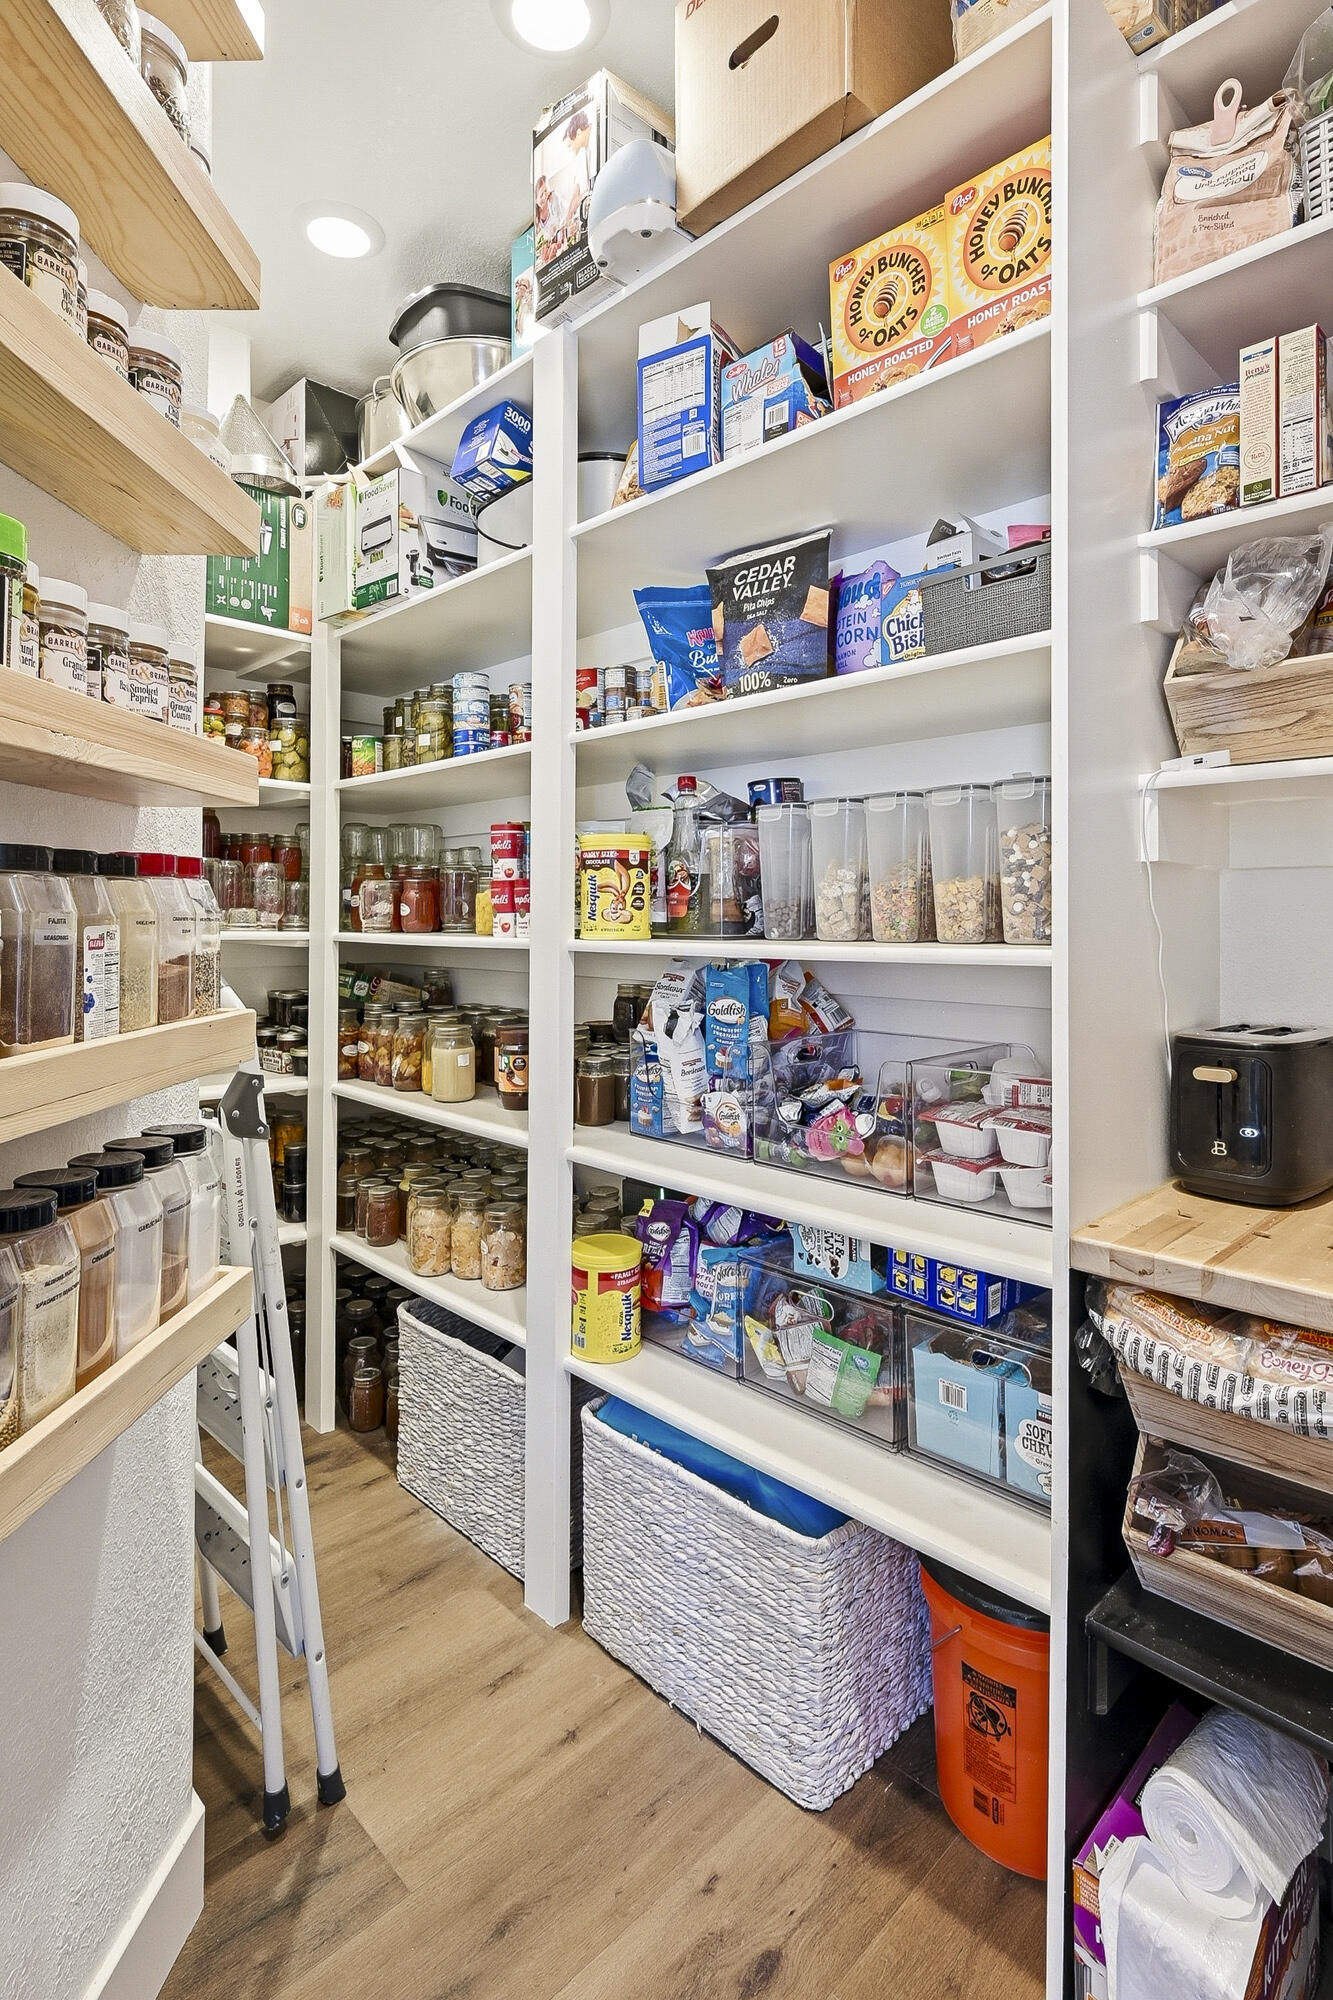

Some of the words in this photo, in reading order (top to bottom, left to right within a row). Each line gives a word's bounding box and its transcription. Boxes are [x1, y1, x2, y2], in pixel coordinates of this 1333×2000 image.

[952, 188, 976, 214] Post
[968, 192, 1000, 264] HONEY
[1198, 211, 1230, 222] Enriched
[1198, 221, 1235, 231] Pre-Sifted
[37, 254, 69, 279] BARREL
[835, 260, 853, 281] Post
[998, 236, 1052, 285] OATS
[849, 262, 875, 327] HONEY
[877, 251, 926, 297] BUNCHES
[873, 306, 918, 347] OATS
[967, 303, 1008, 329] HONEY
[774, 339, 785, 351] 12
[847, 361, 882, 386] HONEY
[884, 339, 934, 371] ROASTED
[732, 357, 780, 403] Whales
[504, 406, 531, 432] 3000
[364, 479, 396, 500] FoodSaver
[734, 555, 796, 586] CEDAR
[732, 571, 794, 601] VALLEY
[743, 602, 756, 612] Pita
[756, 597, 775, 608] Chips
[48, 637, 79, 650] BARREL
[129, 683, 159, 697] Smoked
[739, 671, 771, 693] 100%
[783, 676, 798, 684] Zero
[130, 692, 159, 705] Paprika
[170, 701, 192, 713] Ground
[587, 874, 600, 921] Nesquik
[47, 917, 67, 925] FAJITA
[707, 1002, 746, 1017] Goldfish
[234, 1157, 242, 1187] LADDERS
[237, 1198, 245, 1228] GORILLA
[621, 1293, 634, 1342] Nesquik
[1260, 1350, 1312, 1382] Coney
[1263, 1860, 1308, 1997] KITCHEN
